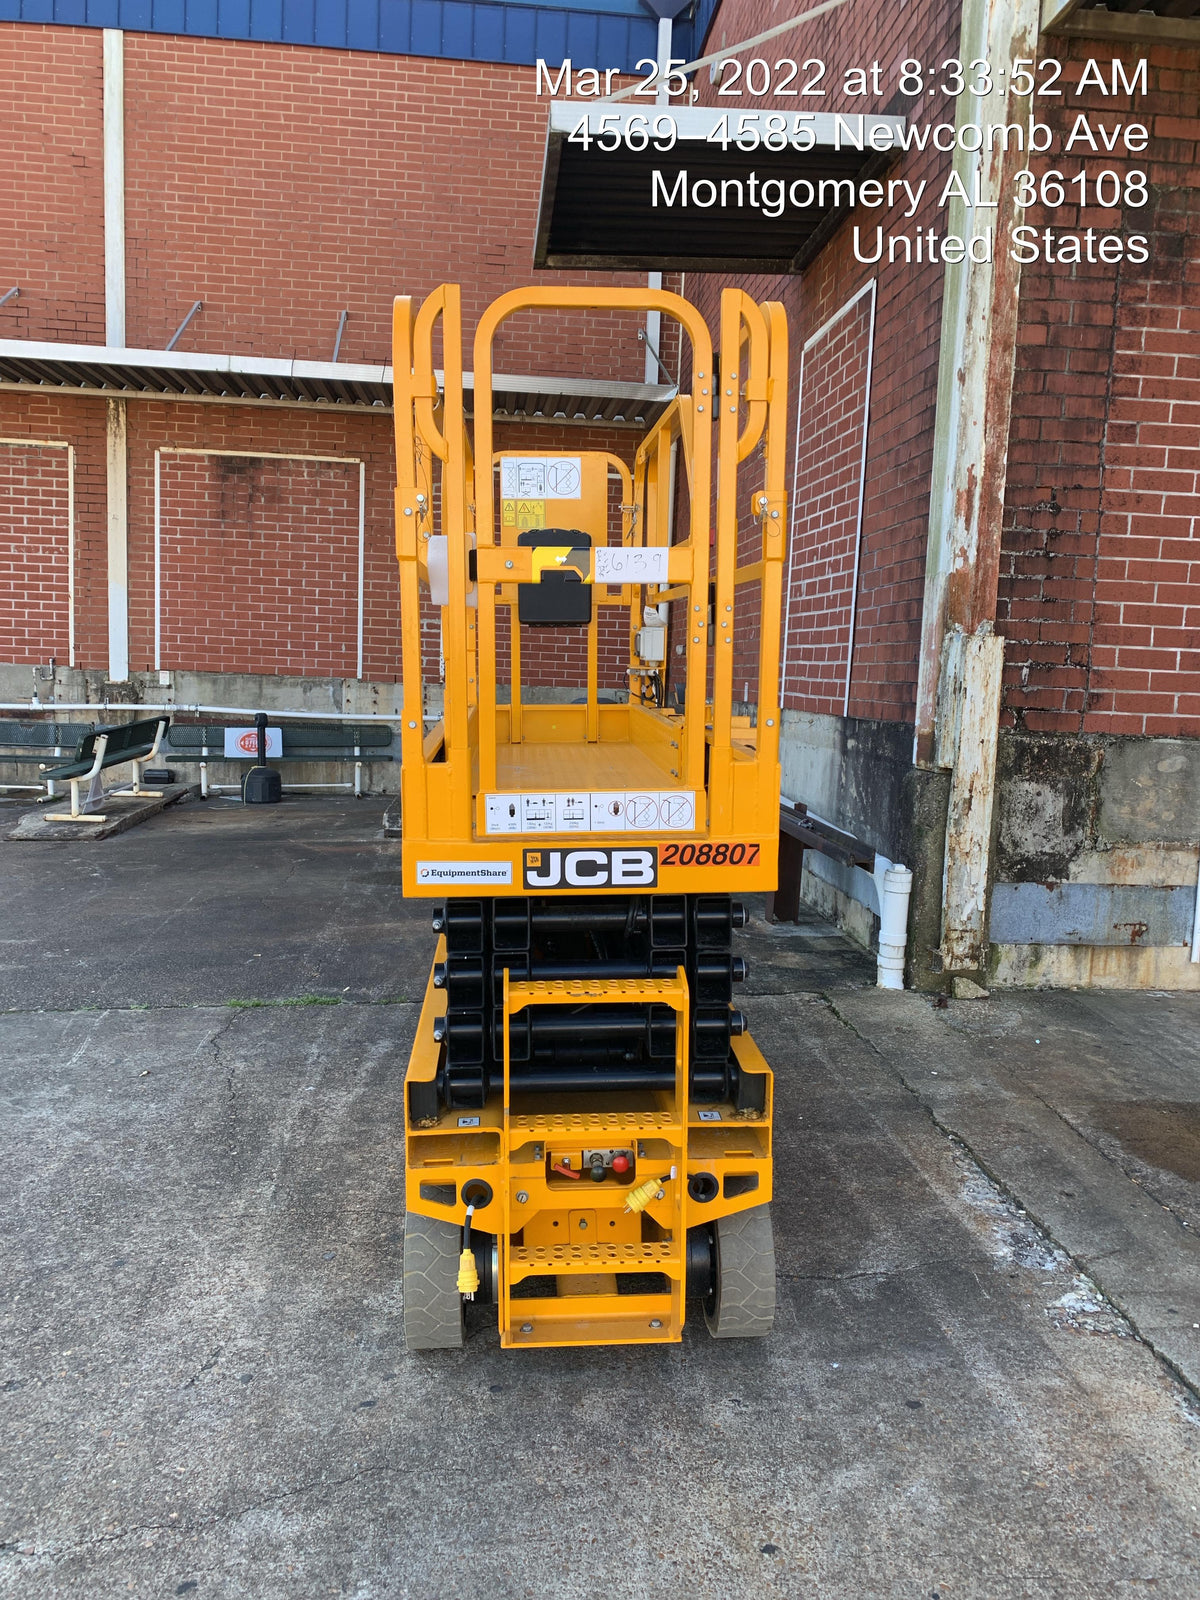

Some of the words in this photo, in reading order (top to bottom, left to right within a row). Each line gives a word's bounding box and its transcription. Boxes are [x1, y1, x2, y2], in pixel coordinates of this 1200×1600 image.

[661, 843, 760, 866] 208807
[431, 869, 507, 877] EquipmentShare
[526, 851, 654, 887] JCB
